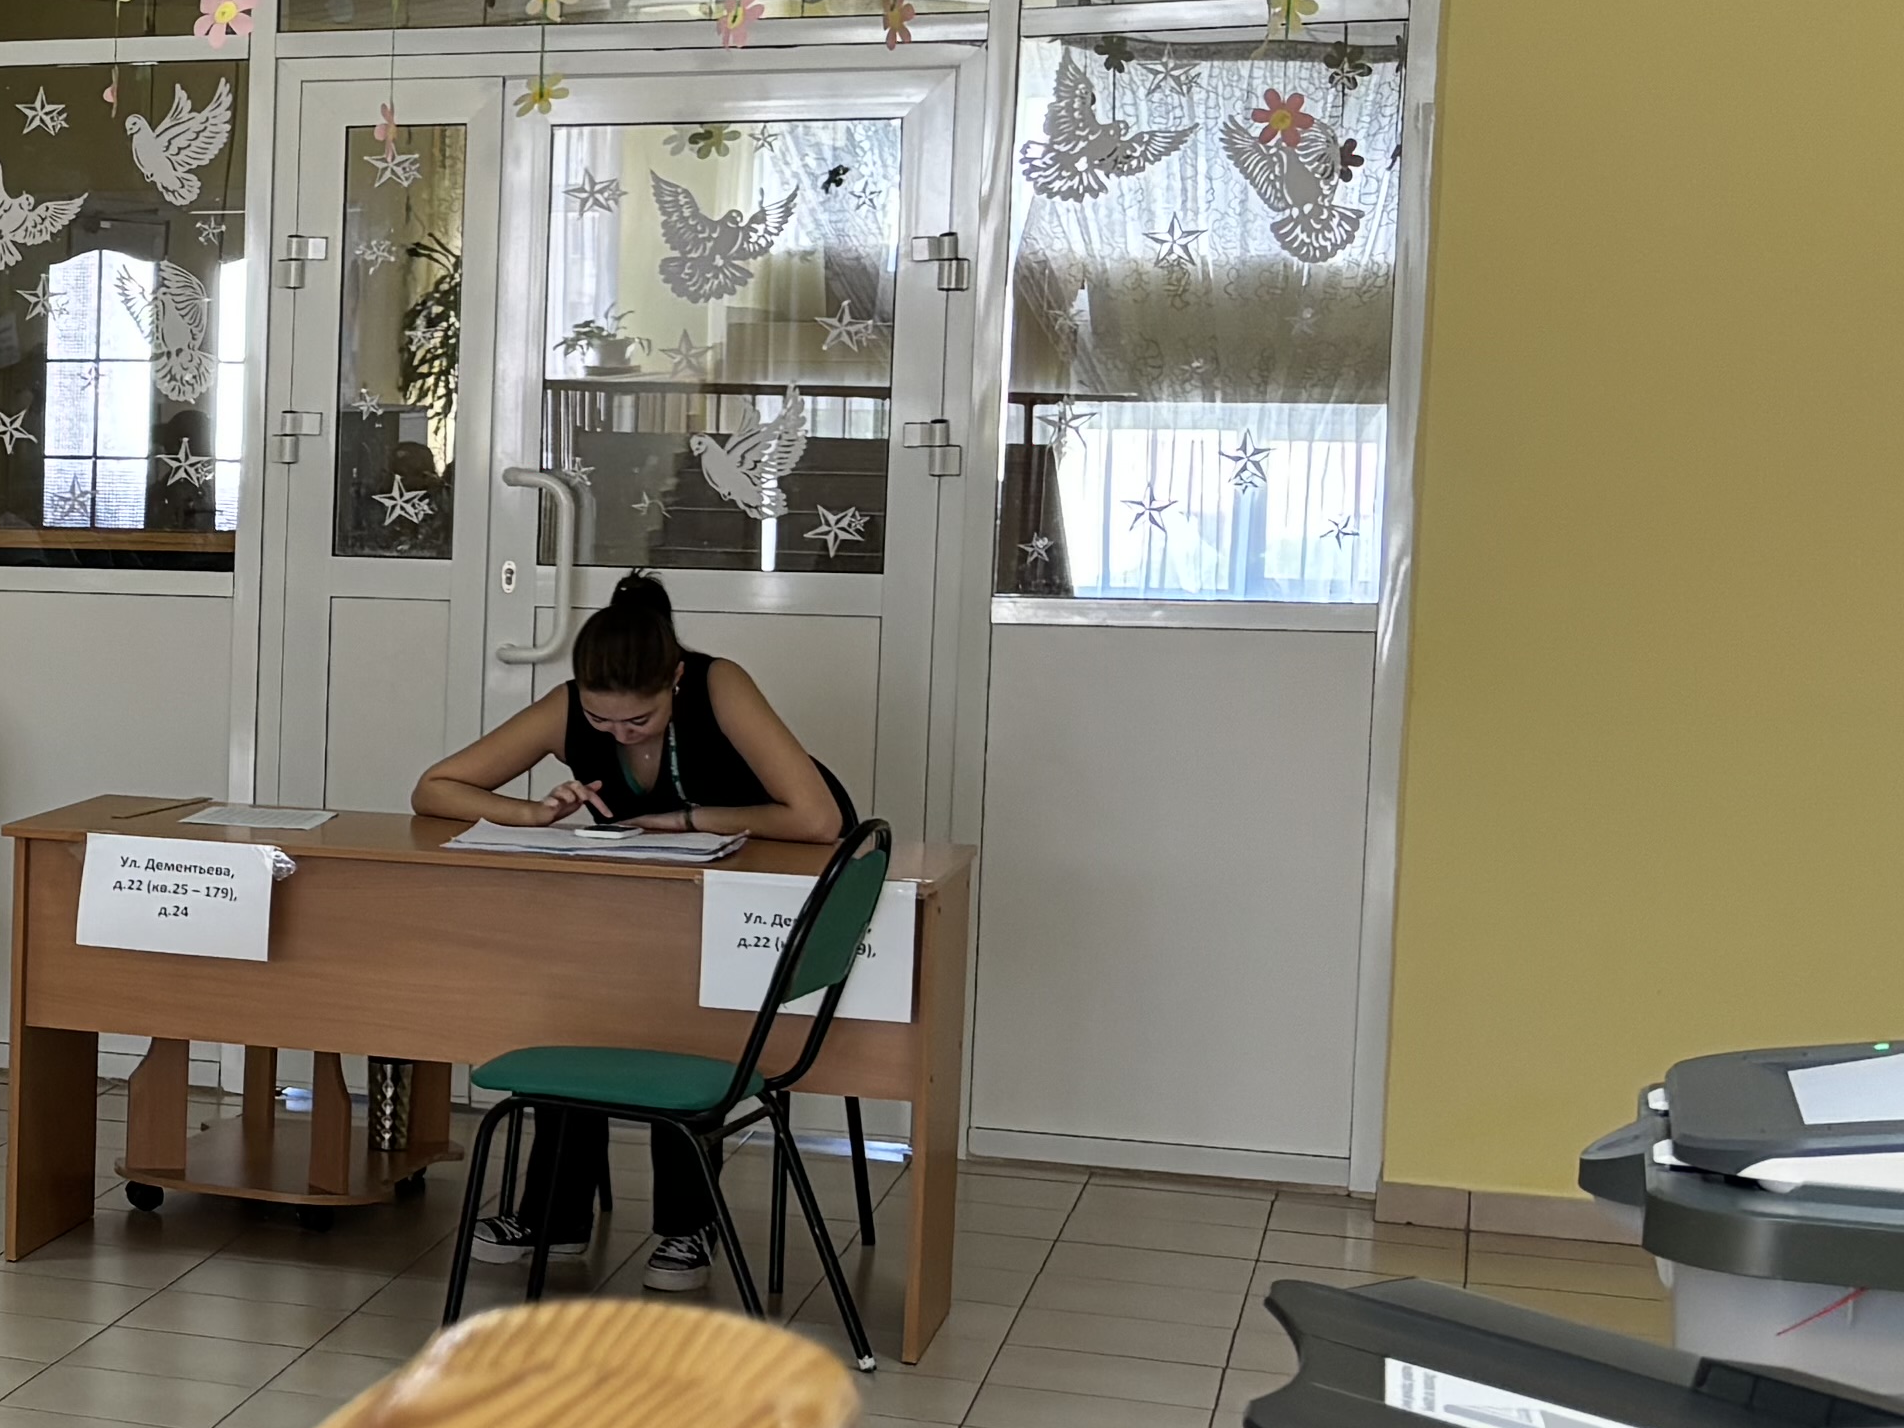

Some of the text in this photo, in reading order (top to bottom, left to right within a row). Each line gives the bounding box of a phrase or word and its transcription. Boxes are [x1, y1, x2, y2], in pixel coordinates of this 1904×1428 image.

[120, 856, 235, 879] Ул. Дементьева,
[113, 879, 143, 891] д.22
[147, 880, 188, 895] (кв.25
[205, 886, 237, 902] 179),
[158, 905, 189, 917] д.24
[744, 912, 767, 925] Ул.
[737, 936, 770, 949] д.22
